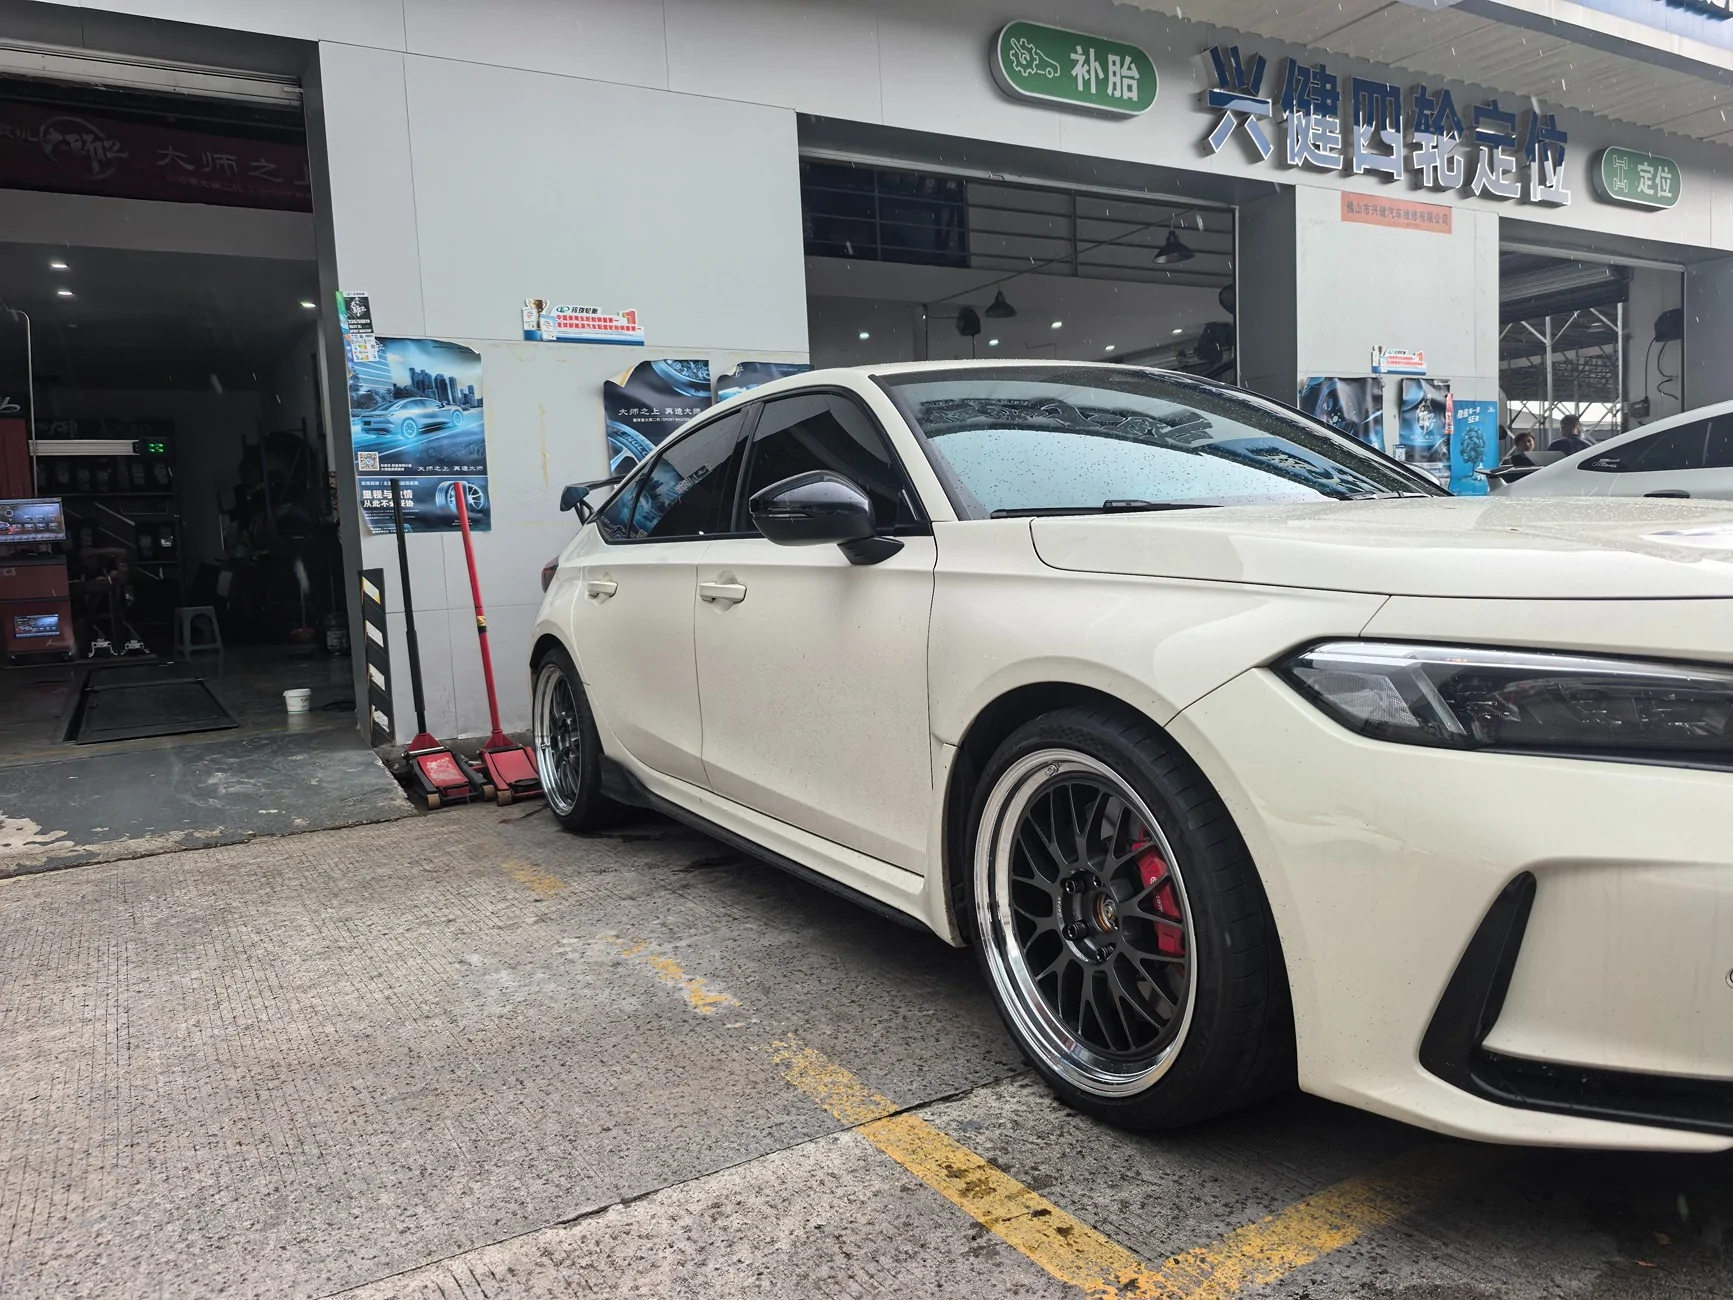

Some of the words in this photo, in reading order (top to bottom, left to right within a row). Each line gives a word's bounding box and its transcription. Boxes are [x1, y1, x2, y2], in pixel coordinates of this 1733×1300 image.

[1070, 45, 1140, 102] 补胎
[1206, 44, 1572, 206] 兴健四轮定位
[1637, 162, 1673, 198] 定位
[1346, 200, 1449, 226] 佛山市兴健汽车维修有限公司
[618, 407, 661, 416] 大师之上
[664, 407, 701, 416] 再造大师
[362, 490, 413, 499] 里程与情
